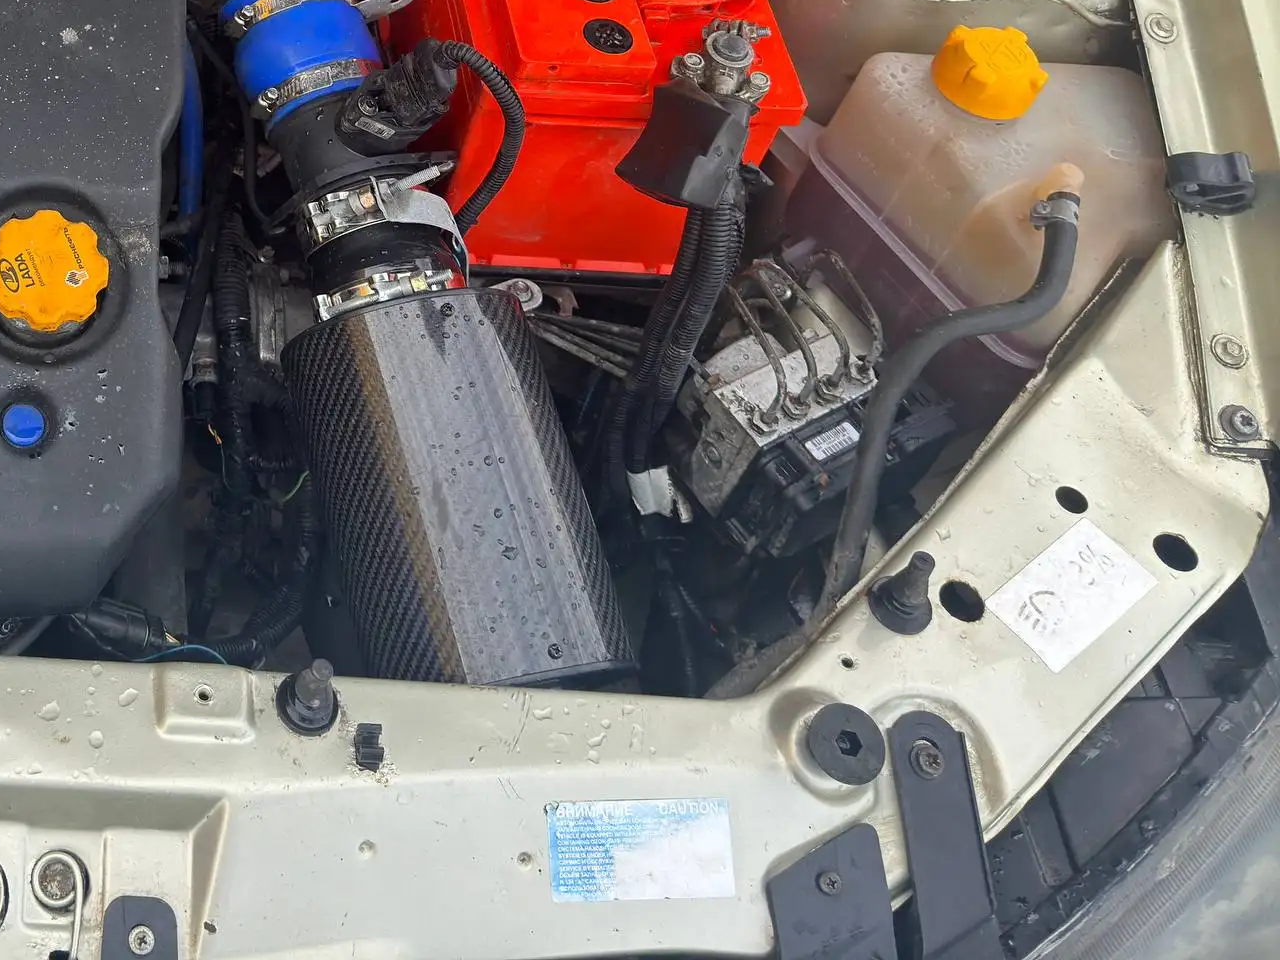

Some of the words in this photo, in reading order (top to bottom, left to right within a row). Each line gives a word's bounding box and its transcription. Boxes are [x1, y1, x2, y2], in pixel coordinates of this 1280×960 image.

[15, 253, 36, 287] LADA
[557, 805, 633, 818] ВНИМАНИЕ
[658, 802, 719, 815] CAUTION
